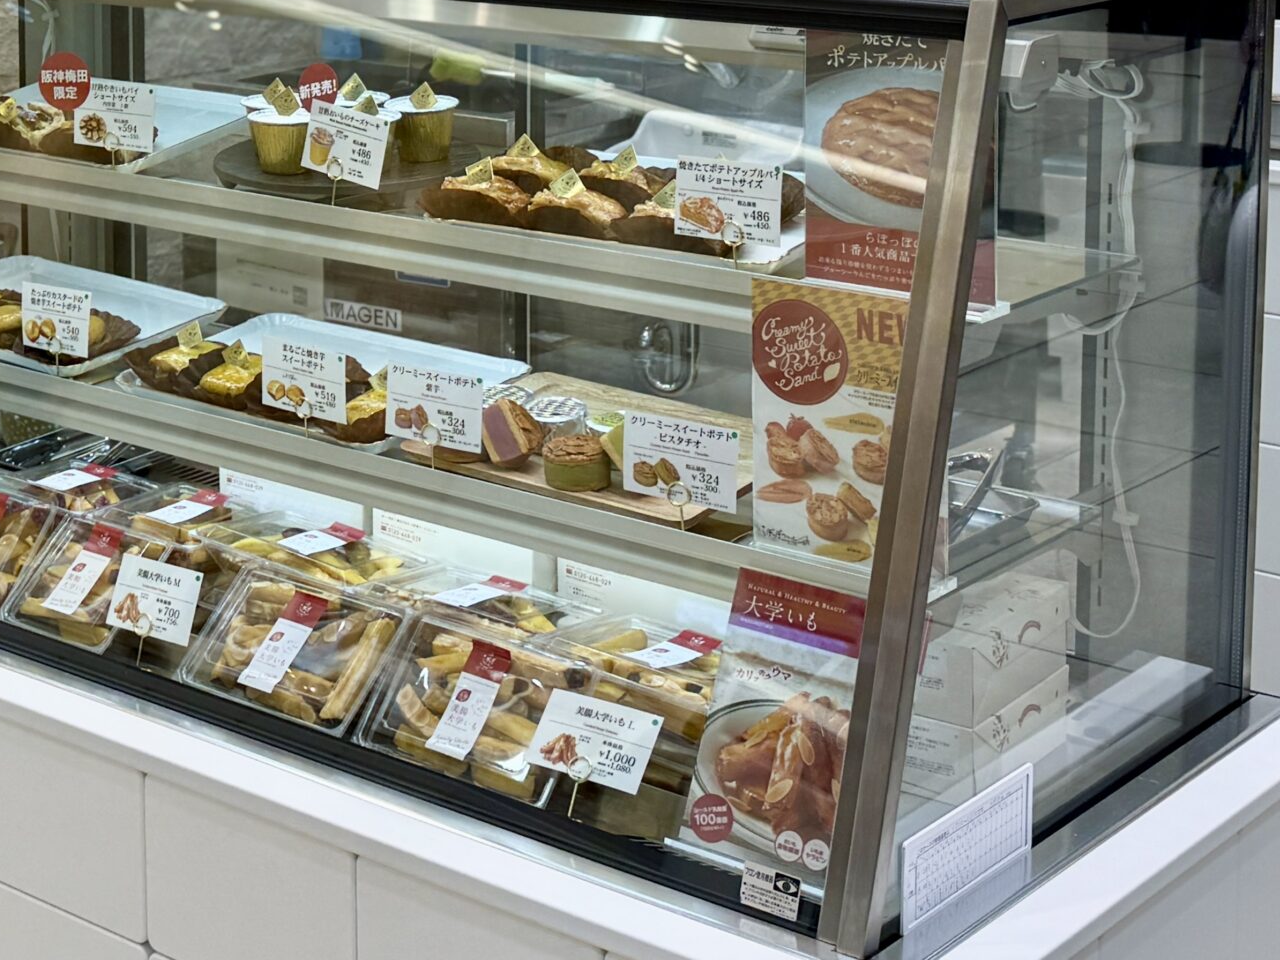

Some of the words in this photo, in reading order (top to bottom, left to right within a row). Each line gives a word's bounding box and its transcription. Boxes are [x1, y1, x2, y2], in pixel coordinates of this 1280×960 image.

[827, 45, 946, 72] ポテトアップルパ
[41, 69, 88, 83] 阪神梅田
[53, 86, 78, 100] 限定
[94, 92, 136, 103] ショートサイズ
[299, 79, 337, 100] 新発売!
[352, 148, 372, 160] ¥486
[679, 160, 780, 180] 焼きたてポテトアップルパイ
[708, 175, 763, 189] ショートサイズ
[743, 210, 770, 221] ¥486
[841, 242, 917, 263] 1番人気商品
[31, 288, 84, 304] たっぷりカスタードの
[324, 298, 399, 330] MAGEN
[761, 316, 814, 341] Creamy
[765, 323, 826, 358] Sweet
[282, 354, 325, 371] スイートポテト
[780, 349, 842, 372] Potato
[392, 365, 477, 388] クリーミースイートポテト
[775, 366, 823, 391] Sand
[315, 391, 336, 402] ¥519
[441, 417, 465, 428] ¥324
[631, 415, 732, 442] クリーミースイートポテト
[692, 472, 719, 486] ¥324
[158, 606, 180, 619] ¥700
[743, 595, 817, 631] 大学いも
[599, 749, 636, 768] ¥1,000
